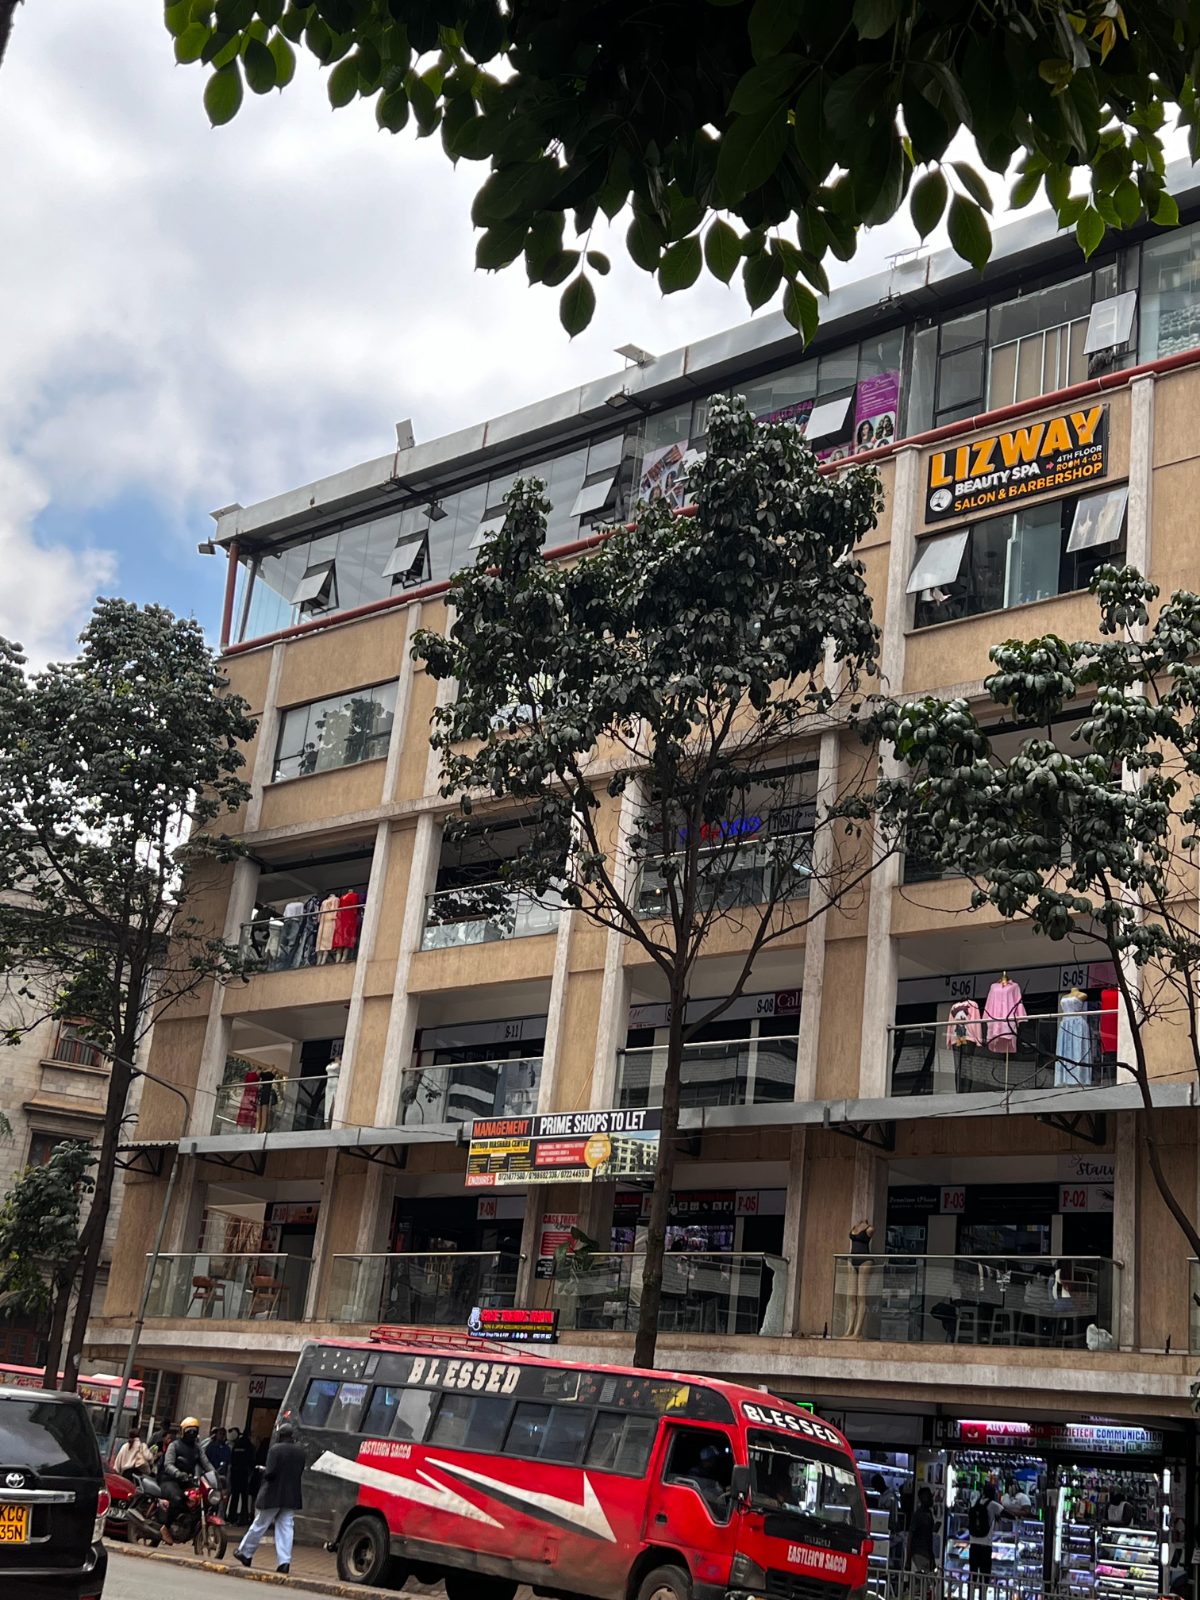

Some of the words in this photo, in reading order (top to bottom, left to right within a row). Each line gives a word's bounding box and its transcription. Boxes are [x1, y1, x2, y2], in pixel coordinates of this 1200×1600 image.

[930, 405, 1103, 488] LIZWAY
[1057, 452, 1073, 463] 4TH
[1074, 445, 1102, 458] FLOOR
[1056, 460, 1080, 472] ROOM
[1081, 453, 1102, 464] 4-03
[954, 488, 996, 512] SALON
[997, 488, 1006, 501] &
[1008, 462, 1103, 499] BARBERSHOP
[955, 470, 1010, 496] BEAUTY
[1011, 462, 1040, 480] SPA
[1062, 970, 1084, 987] S-05
[951, 980, 971, 996] S-06
[473, 1119, 529, 1137] MANAGEMENT
[539, 1117, 572, 1135] PRIME
[573, 1113, 608, 1133] SHOPS
[609, 1112, 624, 1131] TO
[625, 1111, 646, 1129] LET
[944, 1191, 965, 1208] F-03
[1062, 1190, 1085, 1208] F-02
[543, 1214, 560, 1224] CASE
[407, 1357, 521, 1394] BLESSED
[743, 1404, 841, 1445] BLESSED
[1096, 1429, 1163, 1441] COMMUNICATION
[390, 1443, 412, 1459] SACCO
[0, 1505, 25, 1522] KCQ
[824, 1552, 848, 1574] SACCO
